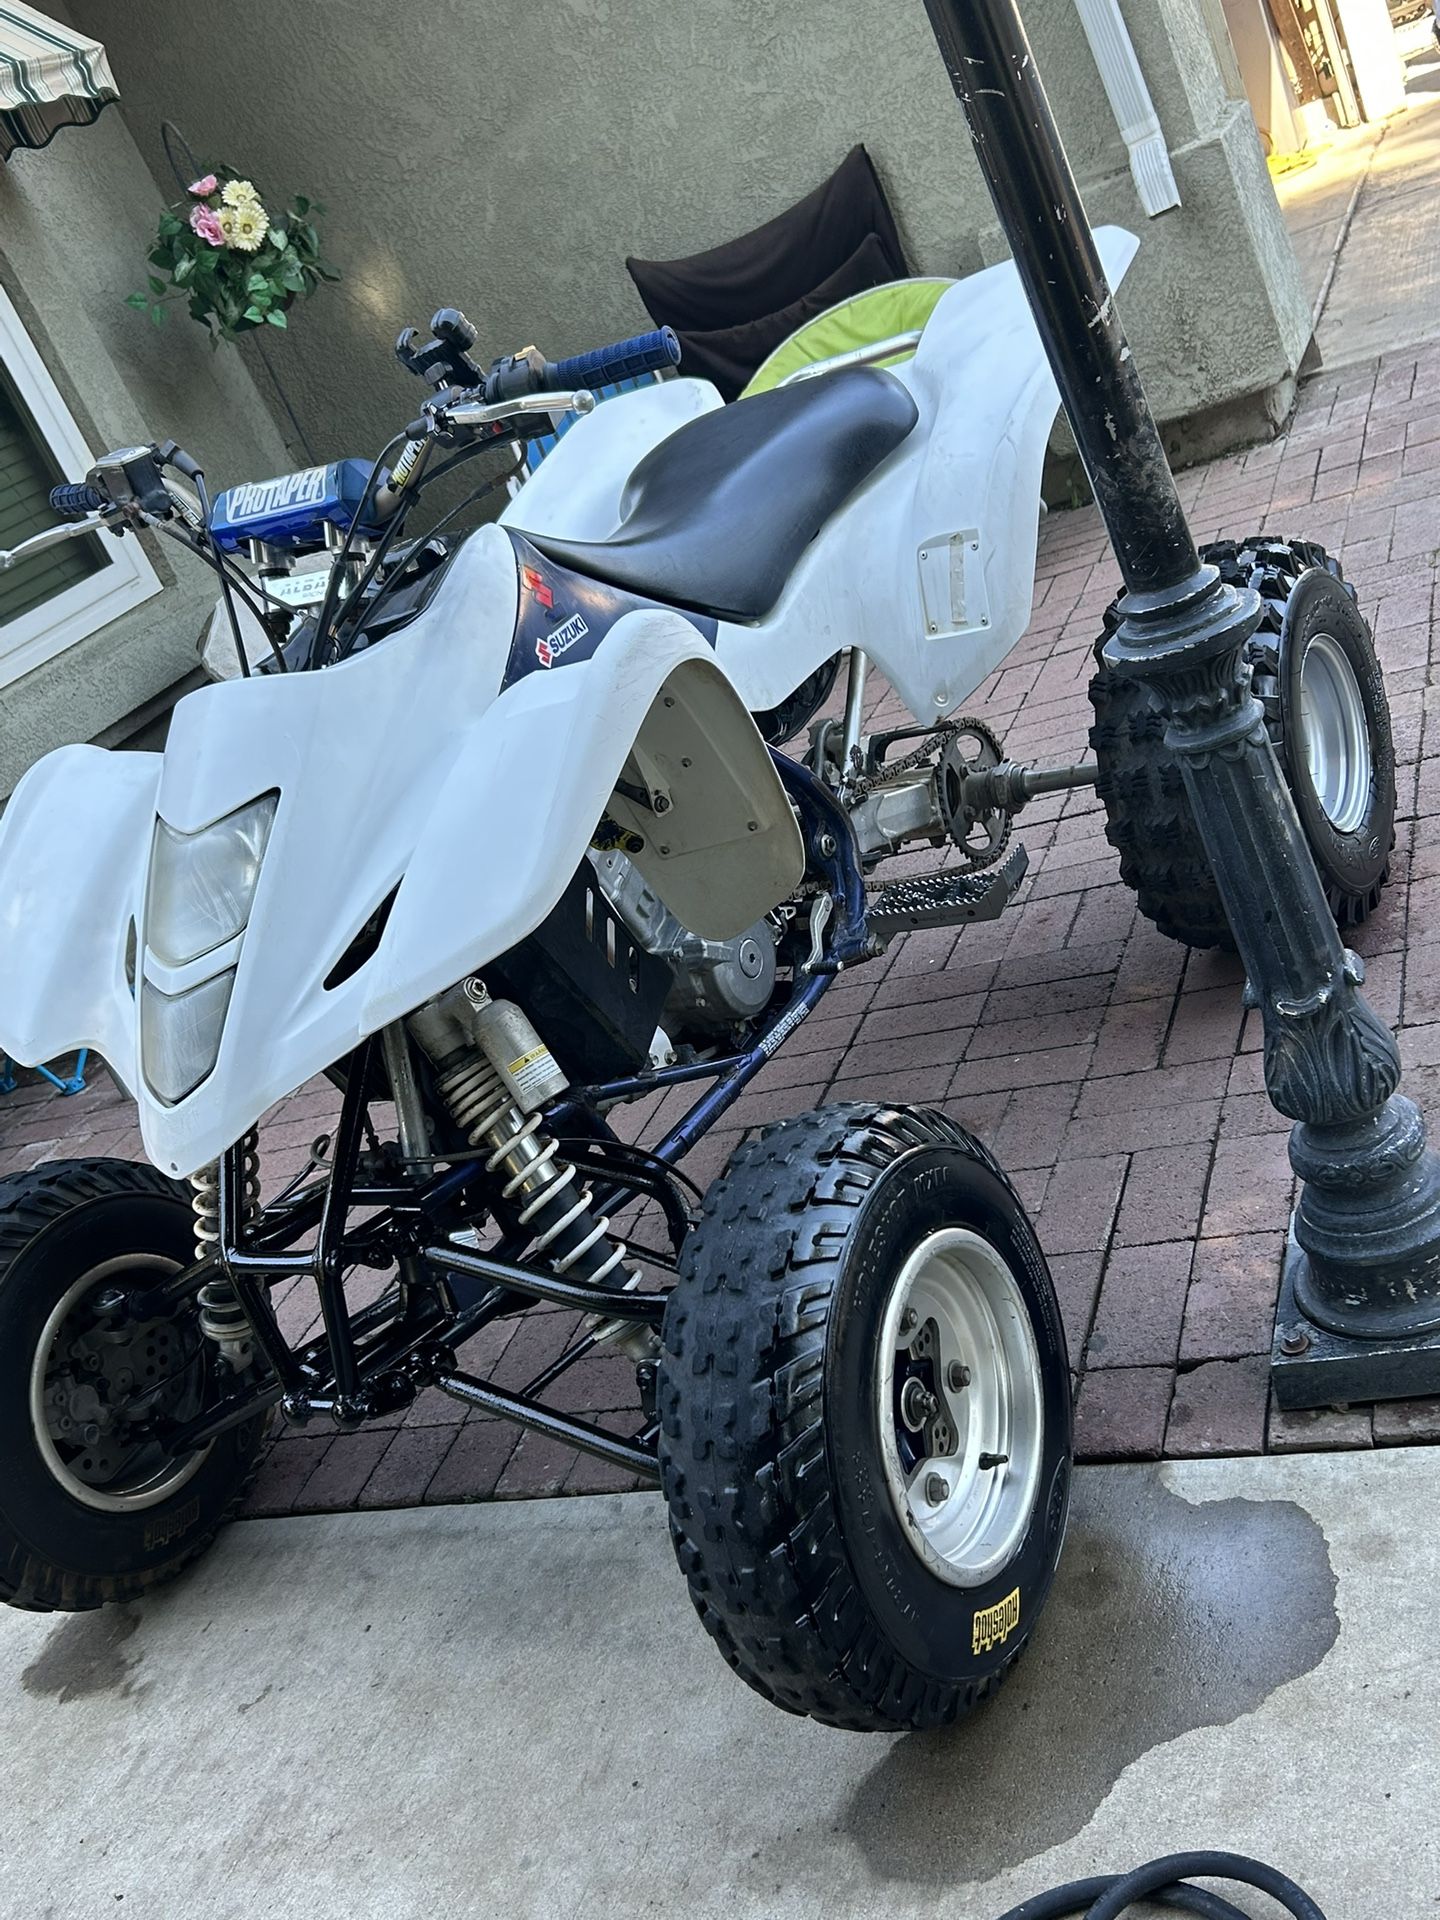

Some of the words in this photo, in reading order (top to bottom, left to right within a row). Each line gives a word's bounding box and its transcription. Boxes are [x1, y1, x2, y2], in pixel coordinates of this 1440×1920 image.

[228, 467, 326, 522] PROTAPER
[549, 616, 587, 654] SUZUKI
[974, 1590, 1019, 1652] Holeshot
